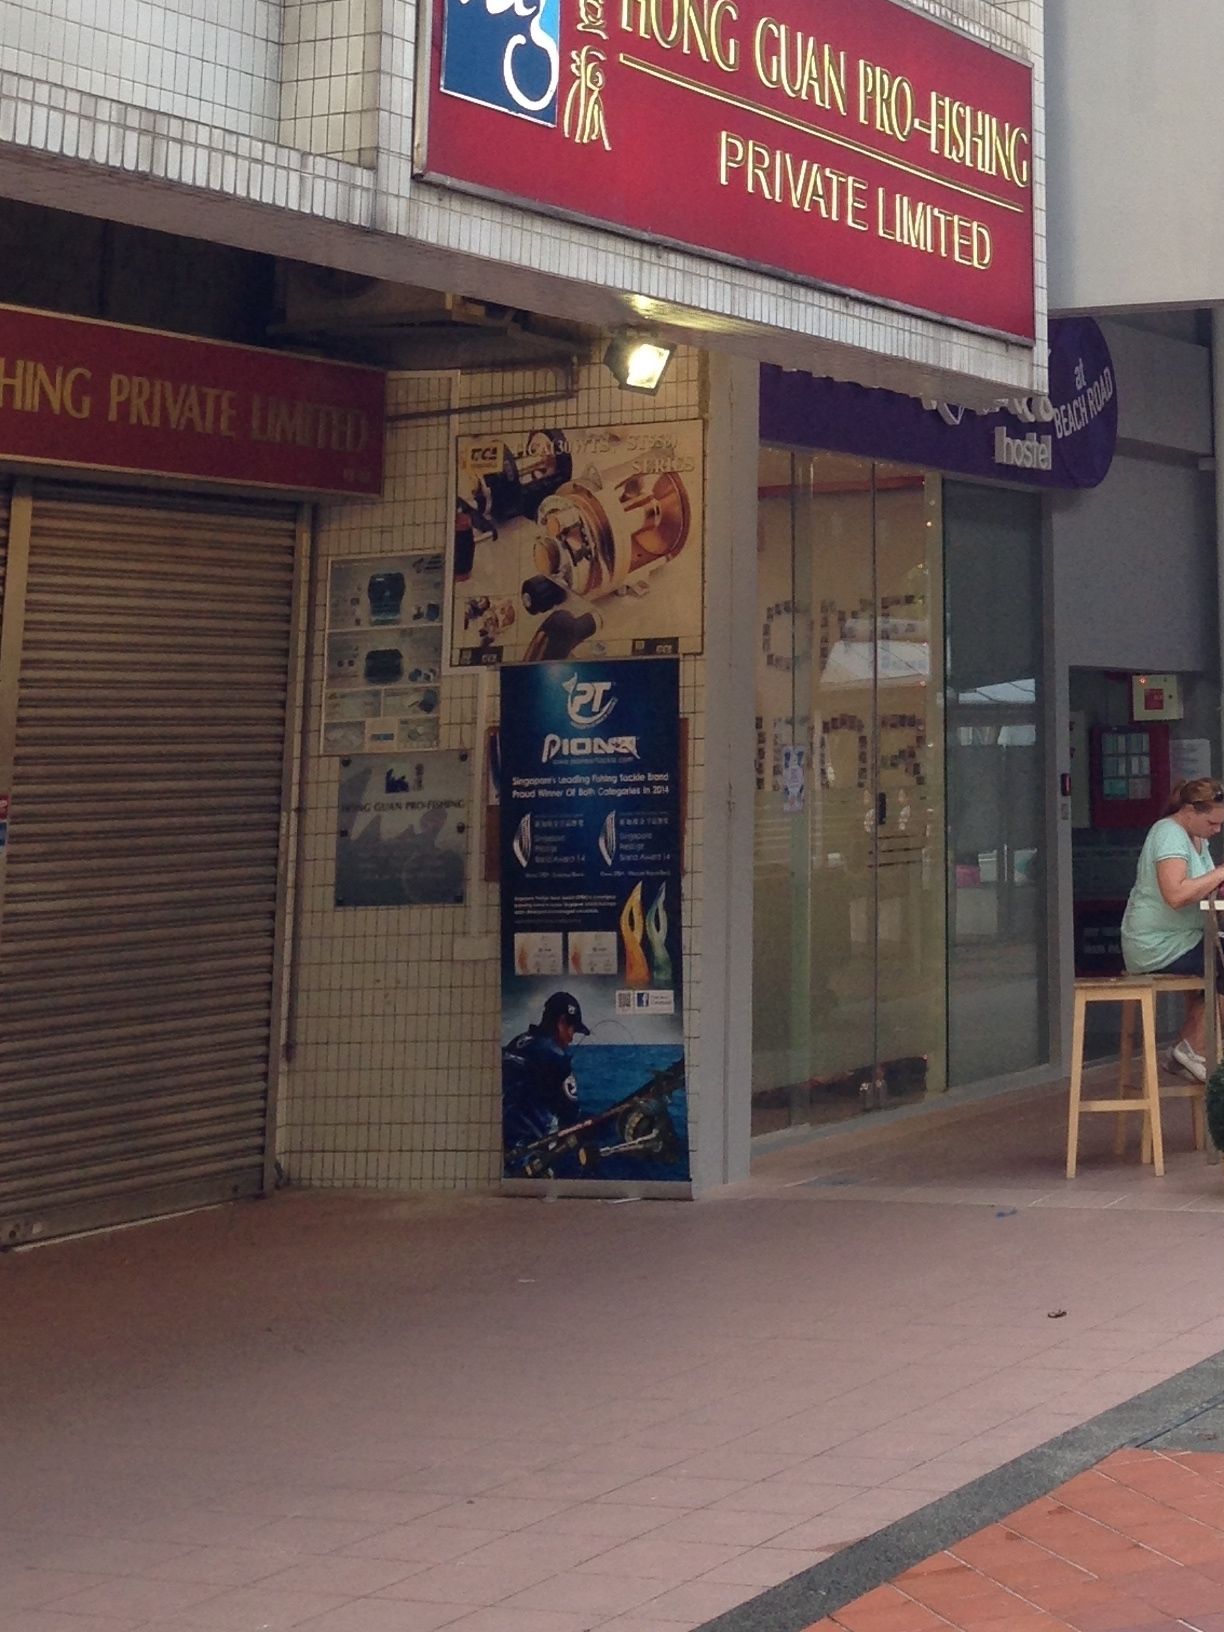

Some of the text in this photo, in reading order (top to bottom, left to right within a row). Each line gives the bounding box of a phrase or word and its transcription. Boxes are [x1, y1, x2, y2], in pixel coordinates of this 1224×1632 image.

[754, 16, 849, 116] GUAN
[858, 58, 1030, 188] PRO-FISHING
[719, 130, 992, 270] PRIVATE LIMITED
[1052, 397, 1089, 440] BEACH
[1087, 365, 1114, 418] ROAD
[1073, 357, 1086, 391] at
[108, 373, 238, 440] PRIVATE
[250, 393, 369, 454] LIMITED
[994, 425, 1052, 471] hostel
[512, 788, 536, 799] Proud
[538, 789, 563, 798] Winner
[578, 787, 594, 797] Both
[597, 786, 642, 798] Categories
